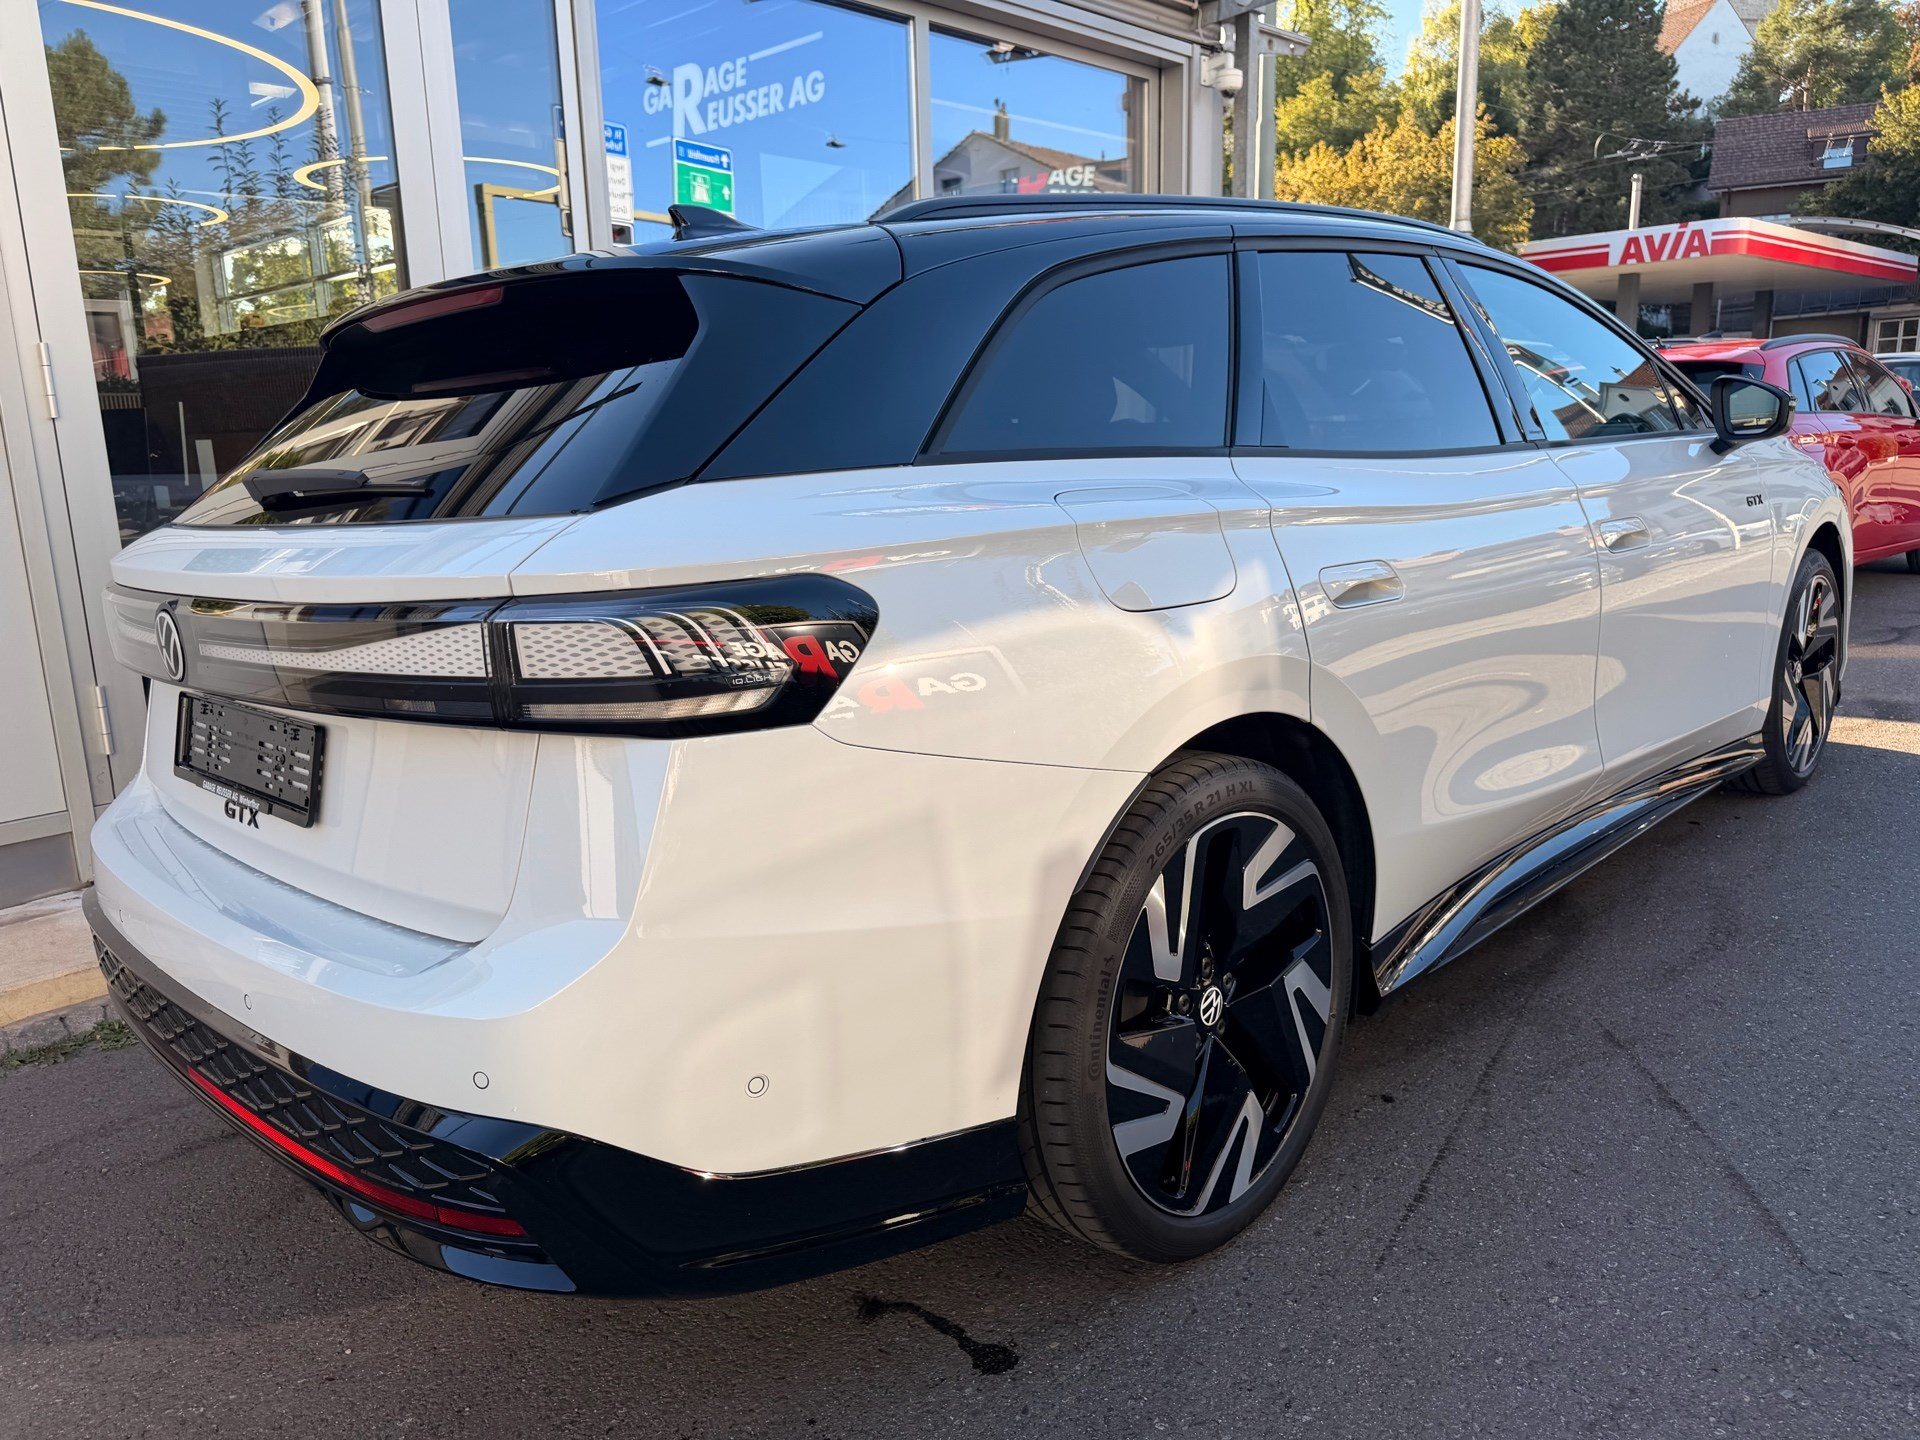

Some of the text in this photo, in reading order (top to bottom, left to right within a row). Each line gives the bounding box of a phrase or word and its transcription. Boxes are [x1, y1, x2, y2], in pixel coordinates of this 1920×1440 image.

[643, 57, 747, 136] GARAGE
[788, 70, 825, 109] AG
[1619, 222, 1710, 265] AVIA
[1746, 494, 1763, 507] GTX
[732, 673, 779, 686] IQ.LIGHT
[1206, 789, 1221, 808] 21
[1225, 783, 1236, 797] H
[1238, 780, 1256, 793] XL
[224, 799, 260, 830] GTX
